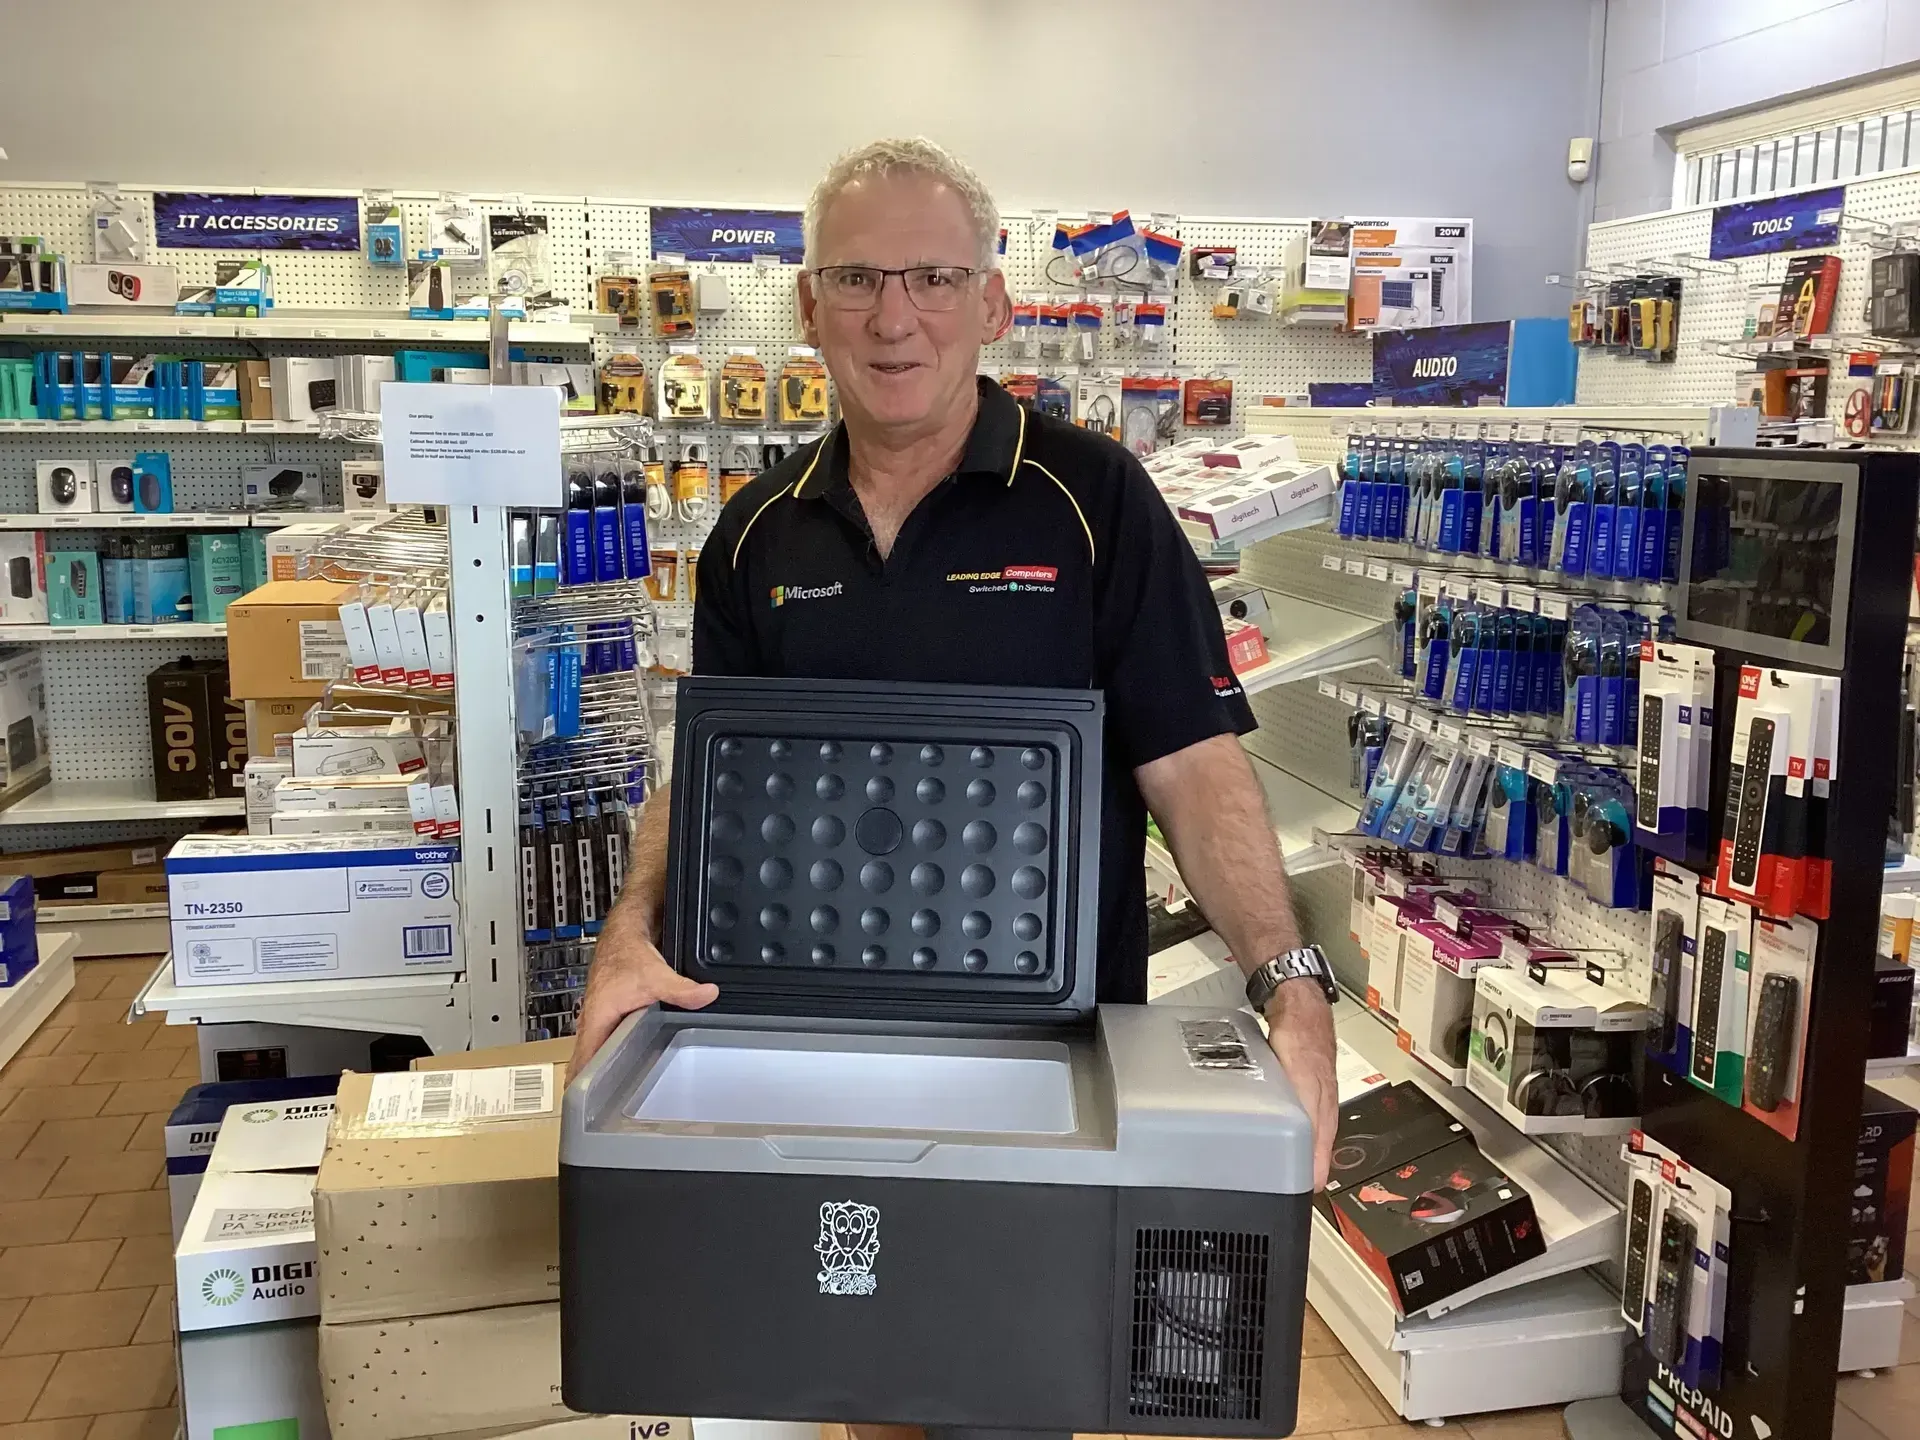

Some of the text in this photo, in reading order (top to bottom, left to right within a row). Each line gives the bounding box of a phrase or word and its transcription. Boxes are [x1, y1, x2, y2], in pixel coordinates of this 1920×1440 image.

[177, 214, 340, 232] IT ACCESSORIES
[1752, 216, 1794, 236] TOOLS
[711, 229, 776, 244] POWER
[1439, 228, 1461, 237] 20W
[1412, 356, 1457, 378] AUDIO
[1259, 455, 1281, 468] digitech
[1290, 482, 1319, 500] digitech
[1231, 506, 1260, 524] digitech
[980, 572, 1001, 580] EDGE
[1005, 569, 1053, 579] Computers
[785, 581, 843, 600] Microsoft
[969, 584, 1008, 593] Switched
[1025, 583, 1055, 593] Service
[1681, 709, 1690, 717] TV
[162, 697, 196, 772] AOC
[1792, 761, 1802, 770] TV
[415, 851, 449, 860] brother
[184, 902, 243, 915] TN-2350
[1433, 947, 1458, 970] digitech
[1738, 954, 1747, 963] TV
[282, 1112, 328, 1120] Audio
[222, 1222, 245, 1230] PA
[251, 1261, 318, 1284] DIGI
[830, 1274, 876, 1285] BRASS
[252, 1283, 305, 1300] Audio
[819, 1281, 877, 1295] MONKEY
